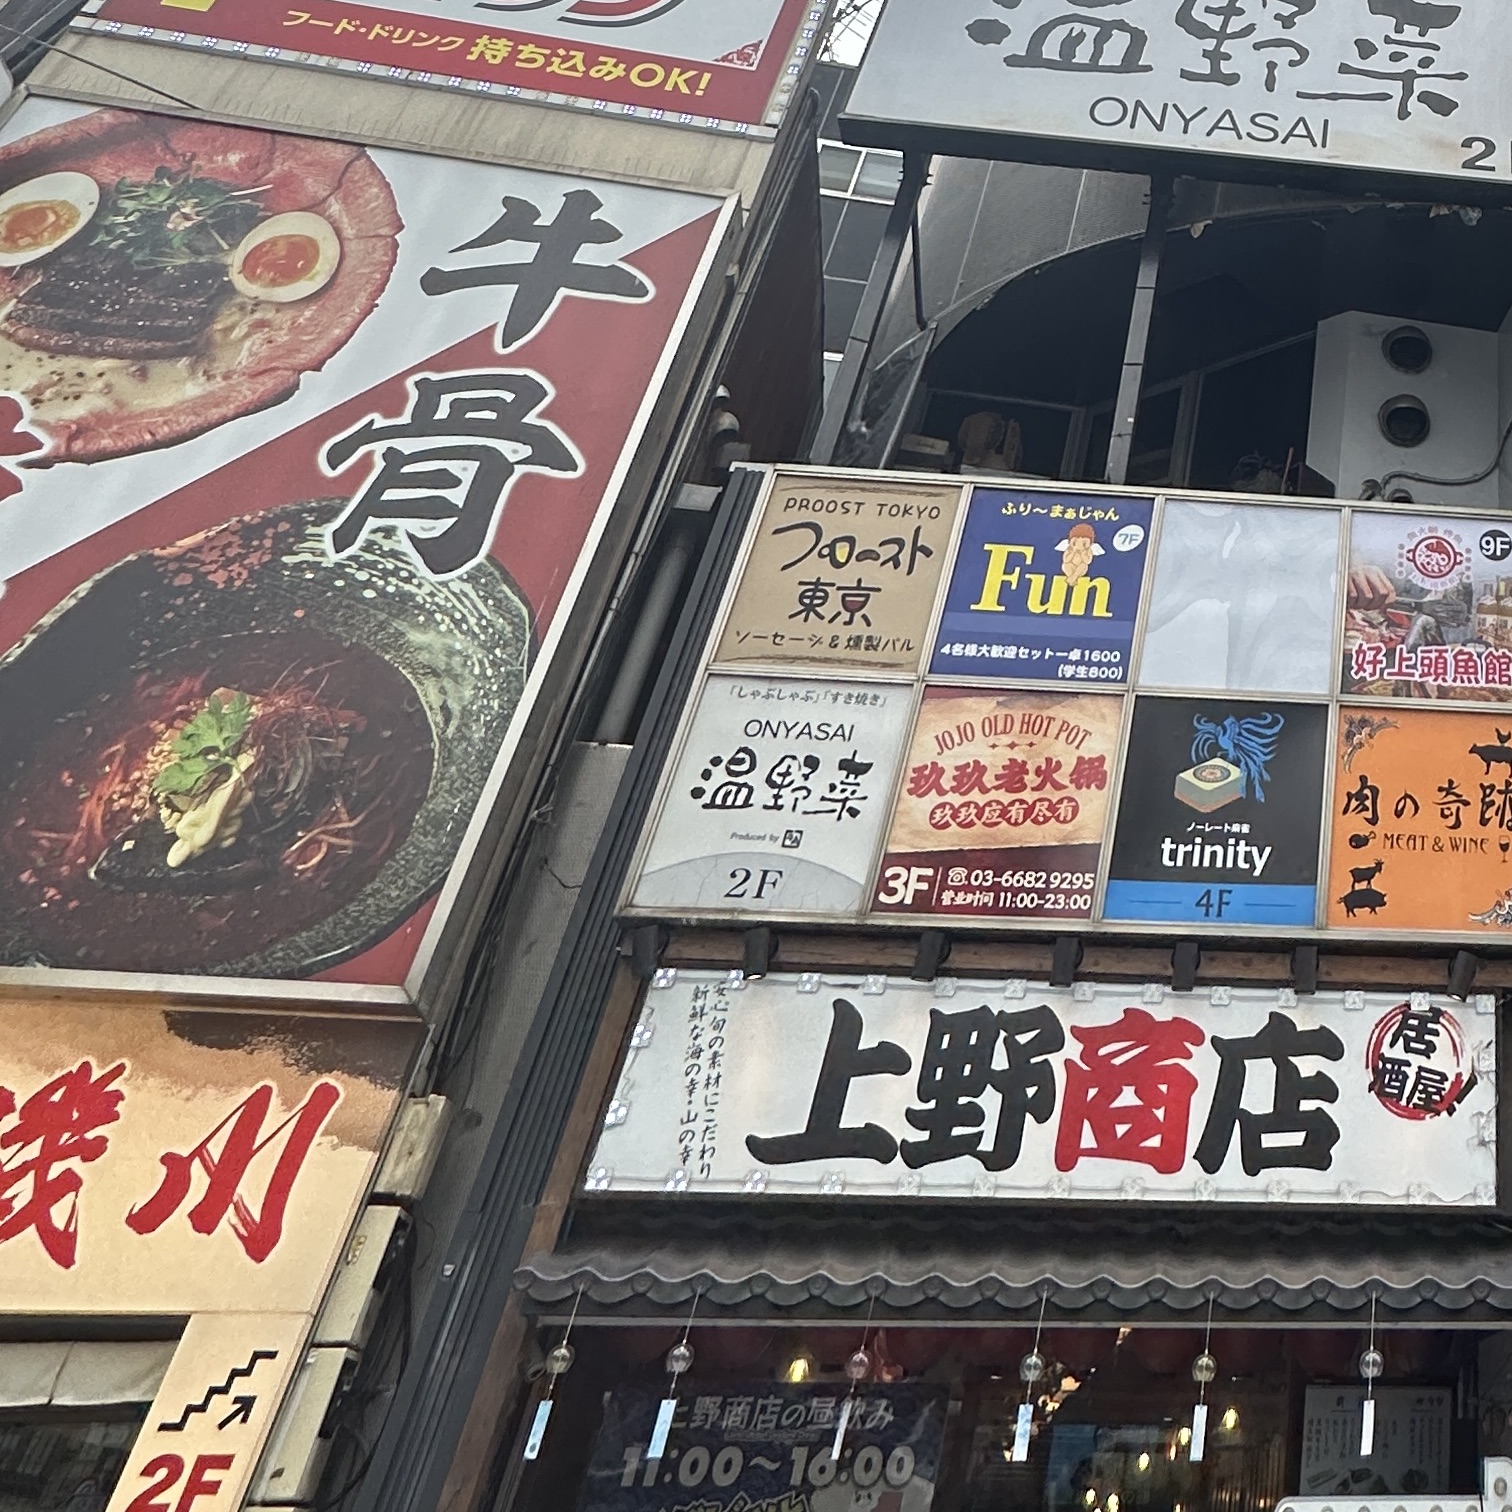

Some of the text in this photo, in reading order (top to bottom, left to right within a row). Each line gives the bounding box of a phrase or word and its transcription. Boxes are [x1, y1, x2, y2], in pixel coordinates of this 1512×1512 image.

[283, 8, 713, 97] フード・ドリンク 持ち込みOK!
[1089, 95, 1329, 149] ONYASAI
[319, 187, 657, 581] 牛骨
[783, 496, 942, 521] PROOST TOKYO
[1116, 529, 1141, 547] 7F
[1480, 537, 1510, 558] 9F
[970, 541, 1114, 620] Fun
[787, 576, 883, 627] 東京
[735, 629, 824, 650] ソーセージ
[1057, 663, 1124, 681] (学生800)
[744, 718, 856, 743] ONYASAI
[933, 712, 1094, 757] JOJO OLD HOT POT
[692, 746, 874, 822] 温野菜
[1161, 836, 1272, 877] trinity
[1382, 832, 1430, 852] MEAT
[1448, 834, 1491, 854] WINE
[724, 867, 784, 900] 2F
[878, 866, 935, 906] 3F
[998, 891, 1092, 911] 11:00-23:00
[1194, 889, 1233, 918] 4F
[744, 997, 1346, 1177] 上野商店
[123, 1452, 236, 1512] 2F
